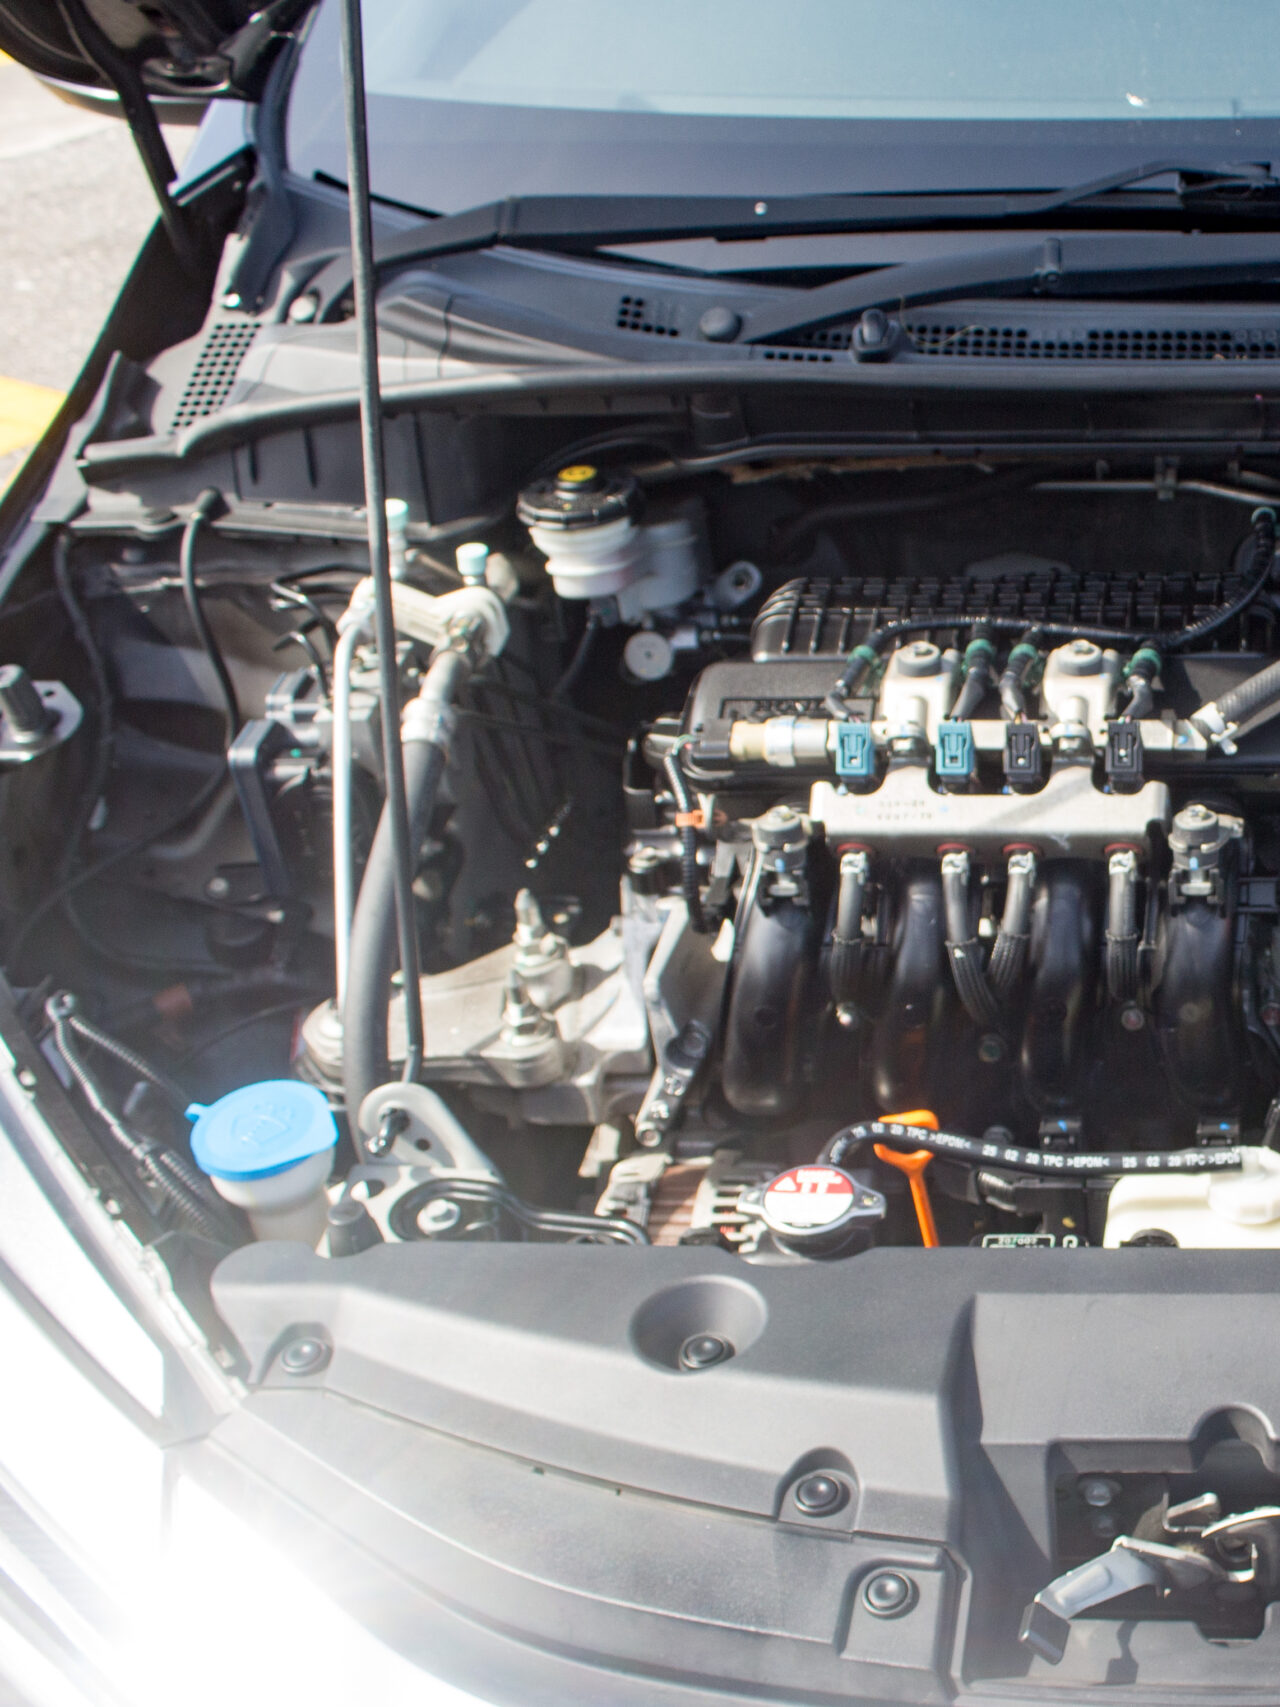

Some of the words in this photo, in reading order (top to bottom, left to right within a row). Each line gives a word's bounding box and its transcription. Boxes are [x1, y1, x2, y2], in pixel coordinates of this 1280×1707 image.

[907, 1126, 928, 1141] TPC
[1004, 1148, 1019, 1162] 02
[1043, 1154, 1064, 1167] TPC
[1146, 1155, 1160, 1167] 02
[1185, 1152, 1206, 1166] TPC
